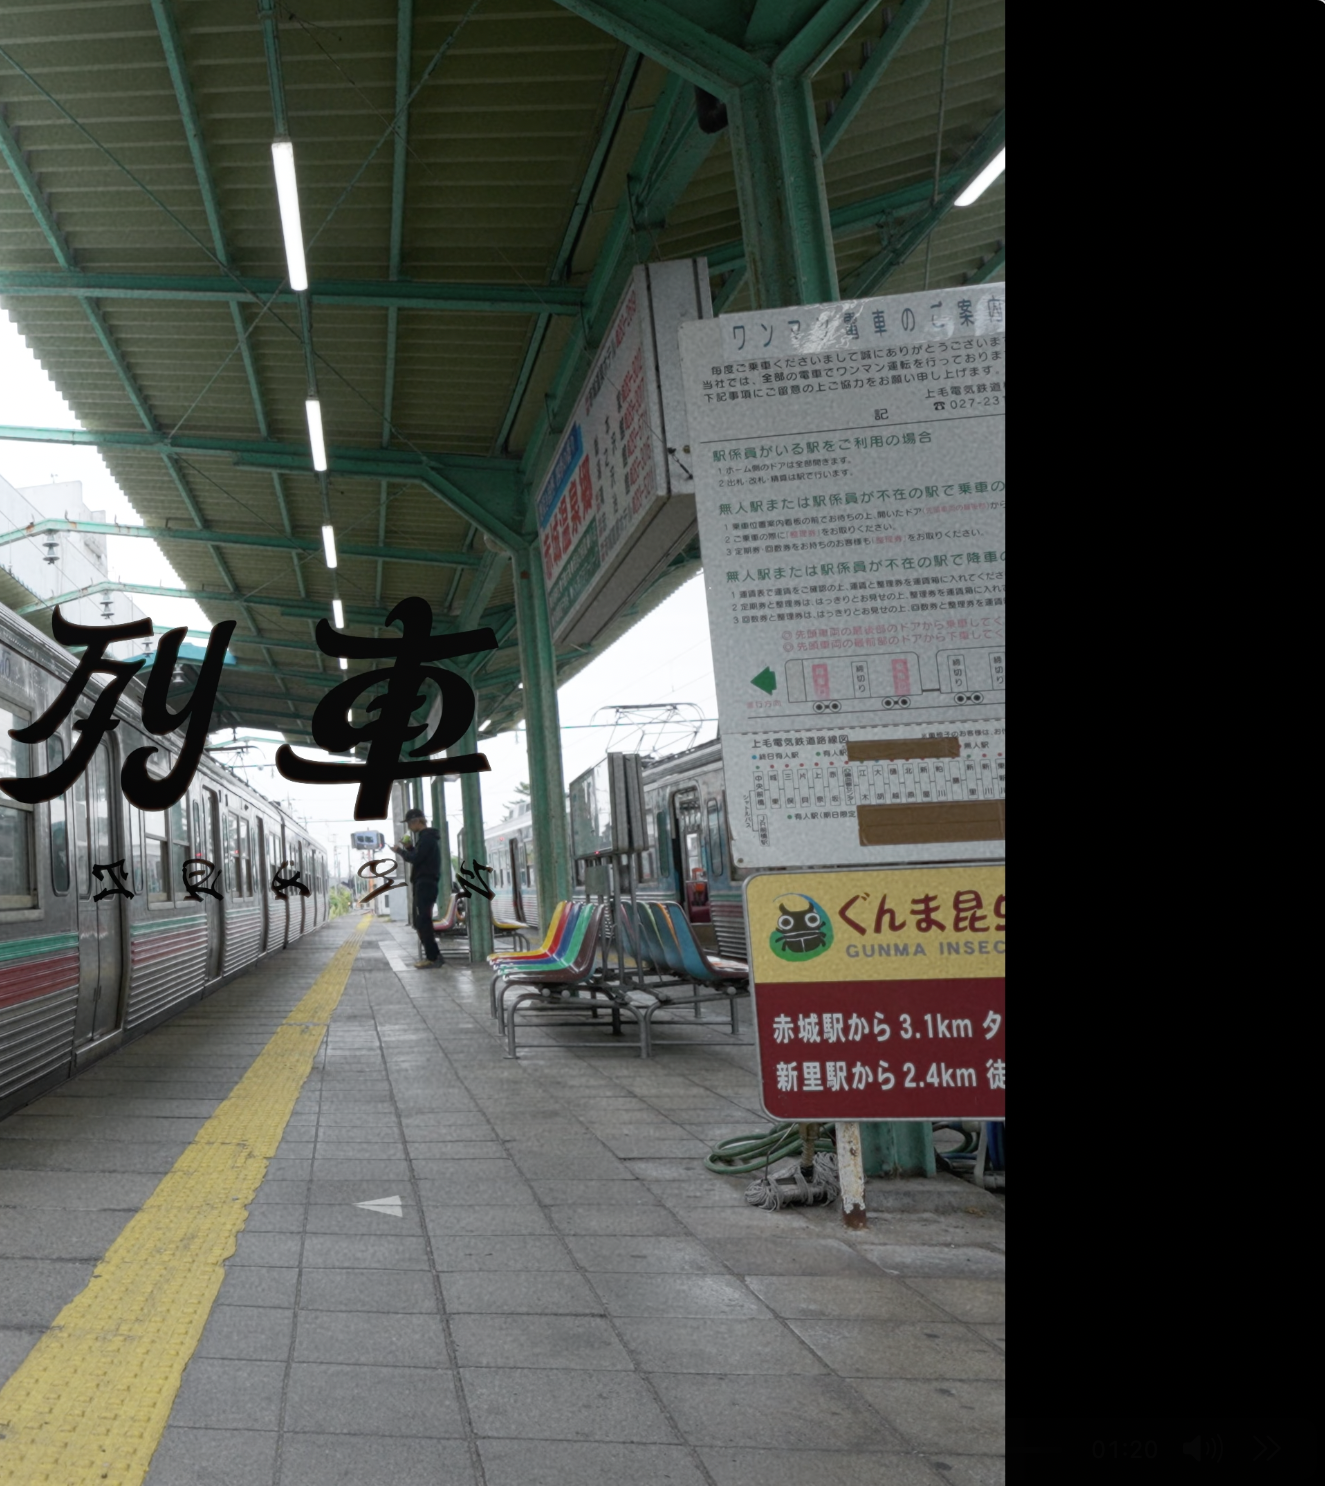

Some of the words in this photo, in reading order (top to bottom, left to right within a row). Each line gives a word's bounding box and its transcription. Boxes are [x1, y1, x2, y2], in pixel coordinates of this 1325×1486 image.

[702, 350, 1005, 390] 当社では、全部の電車でワンマン運転を行っておりま
[711, 336, 1005, 376] 毎度ご乗車くださいまして誠にありがとうございま
[924, 382, 1005, 399] 上毛電気鉄道
[950, 396, 1005, 410] 027-23
[874, 408, 889, 421] 記
[712, 430, 933, 463] 駅係員がいる駅をご利用の場合
[719, 480, 1005, 515] 無人駅または駅係員が不在の駅で乗車の
[741, 597, 1005, 624] 回数券と整理券は、はっきりとお見せの上、回数券と整理券を運賃
[751, 735, 850, 749] 上毛電気鉄道路線図
[759, 751, 799, 760] 終日有人駅
[755, 775, 765, 807] 中央前橋
[859, 769, 869, 801] 江木
[874, 769, 885, 800] 大胡
[981, 763, 993, 795] 新川
[846, 943, 927, 959] GUNMA
[773, 1011, 891, 1044] 赤城駅から
[900, 1012, 973, 1040] 3.1km
[776, 1059, 896, 1092] 新里駅から
[903, 1061, 978, 1088] 2.4km
